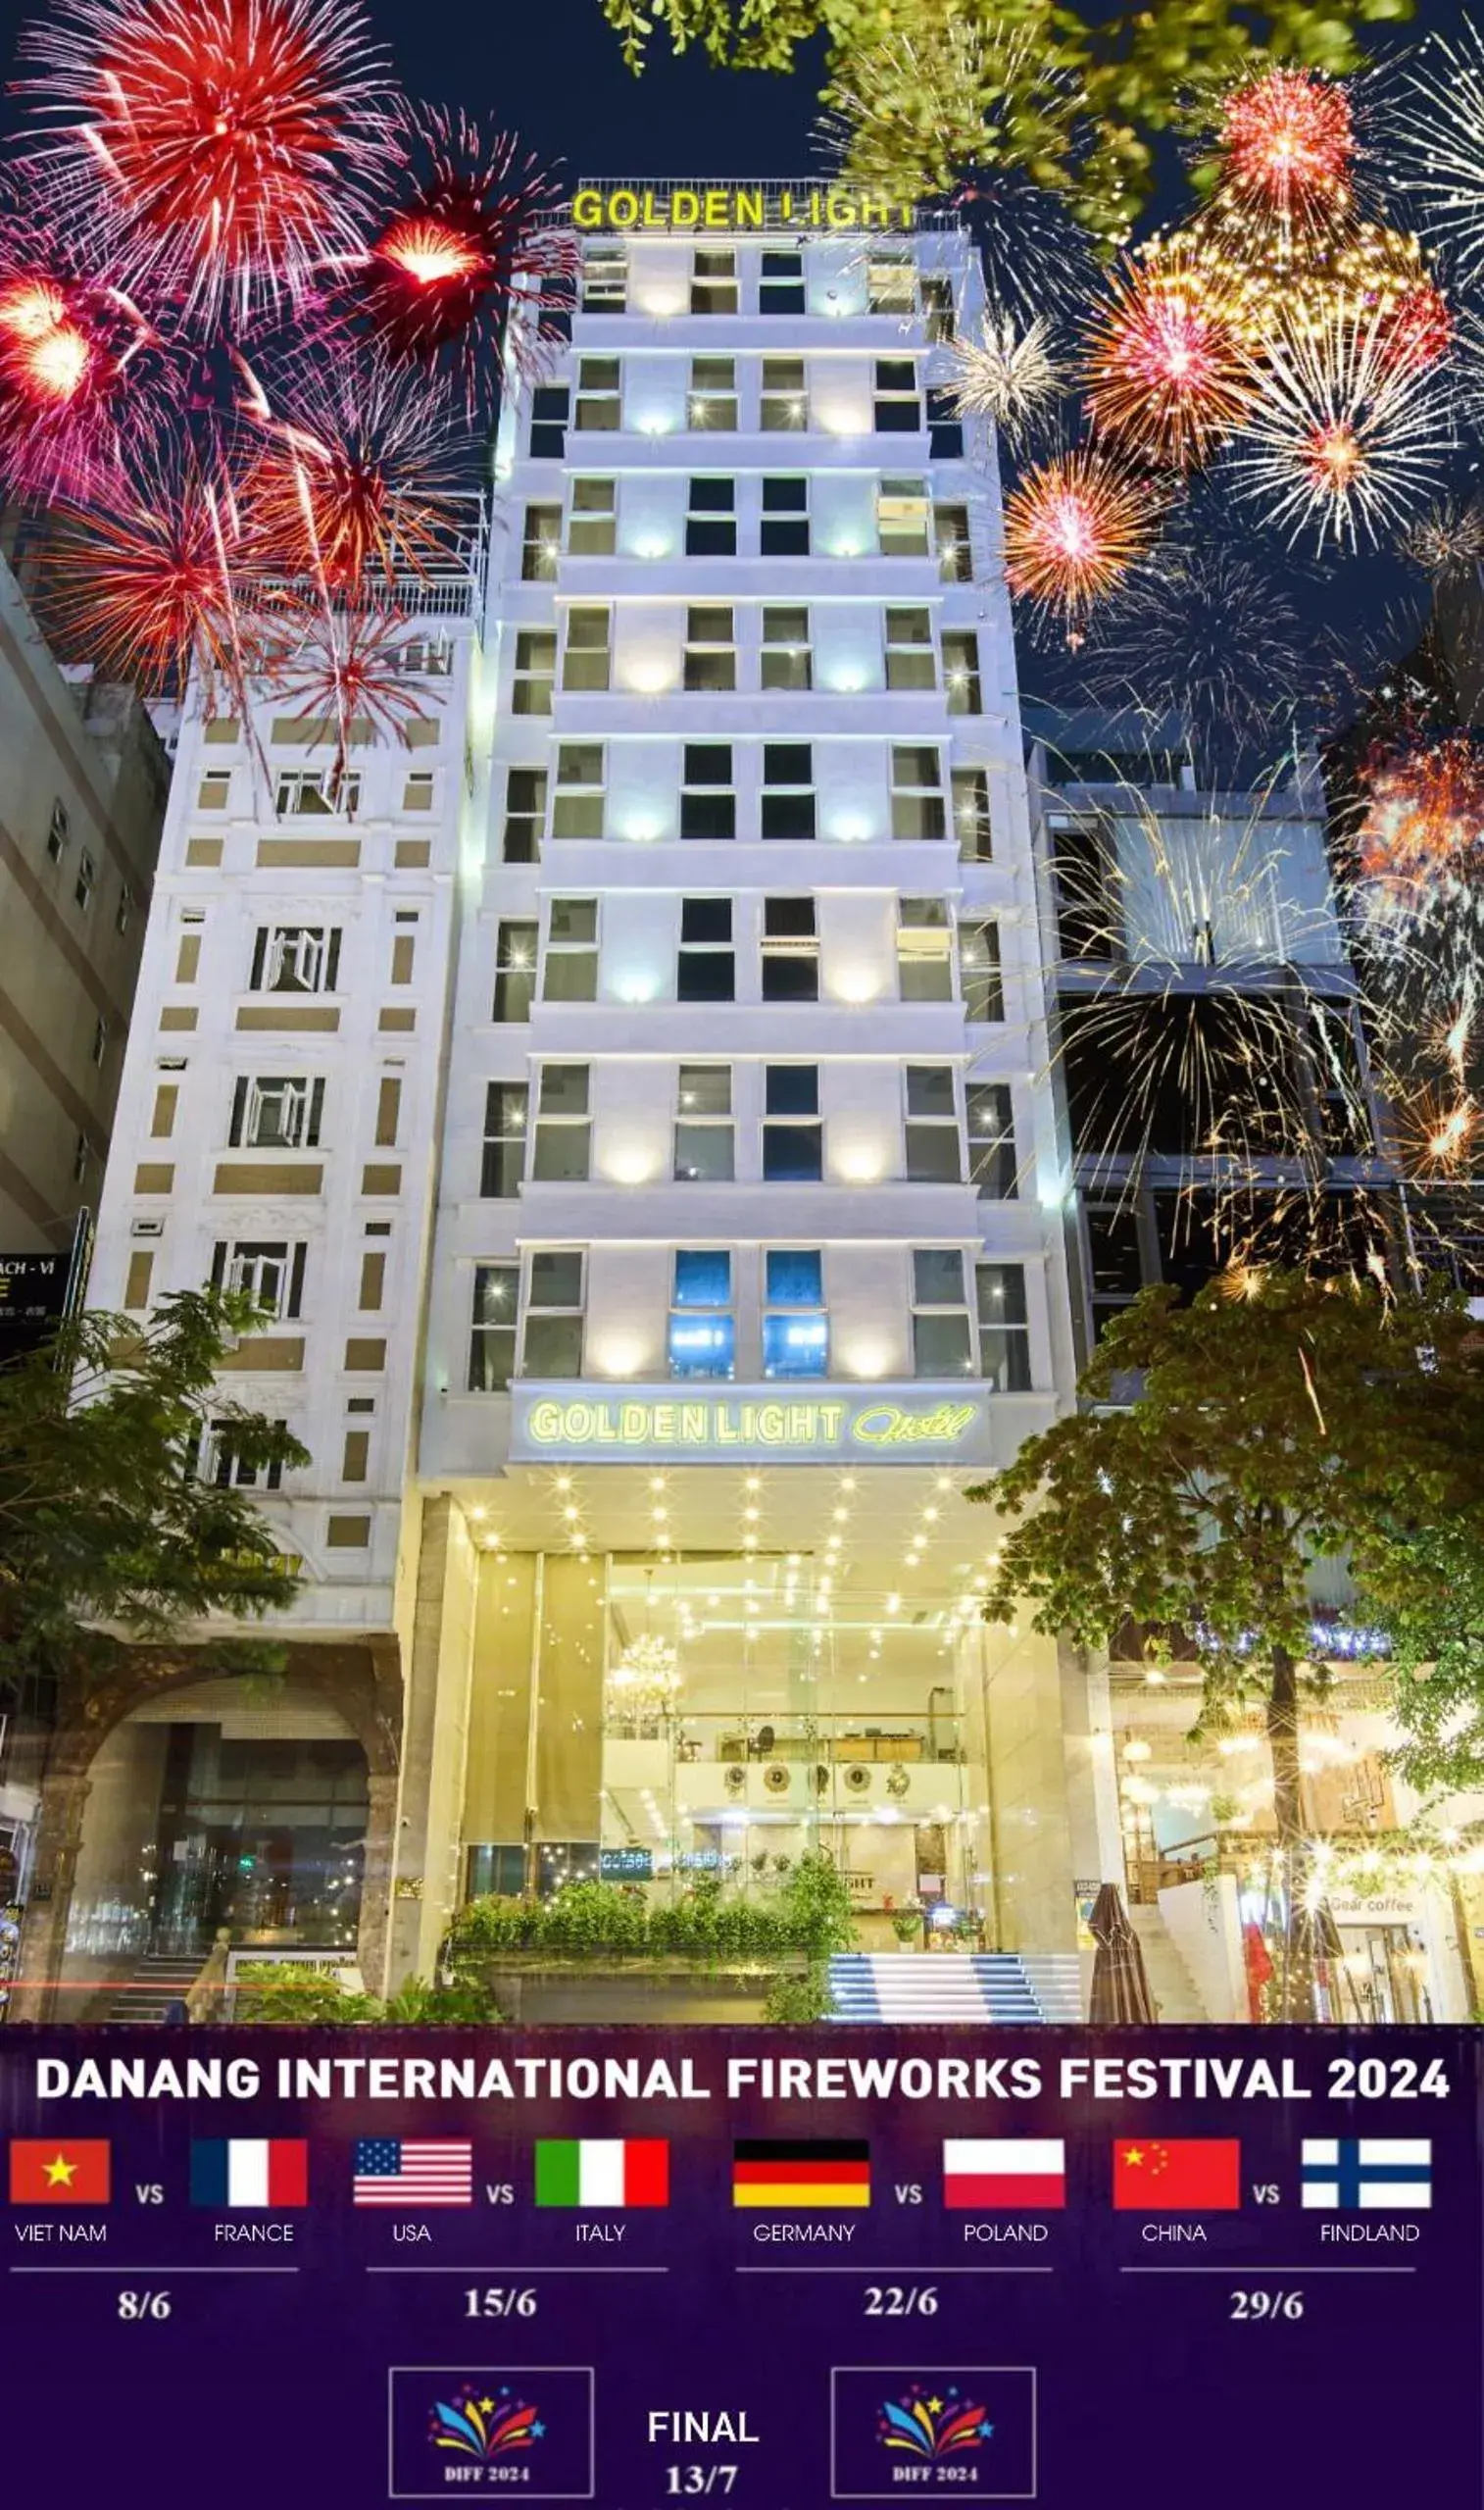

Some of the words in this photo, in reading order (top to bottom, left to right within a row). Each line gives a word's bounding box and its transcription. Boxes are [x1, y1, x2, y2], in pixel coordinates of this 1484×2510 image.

[573, 189, 764, 226] GOLDEN
[530, 1403, 707, 1442] GOLDEN
[715, 1403, 843, 1442] LIGHT
[1367, 1898, 1413, 1912] coffee
